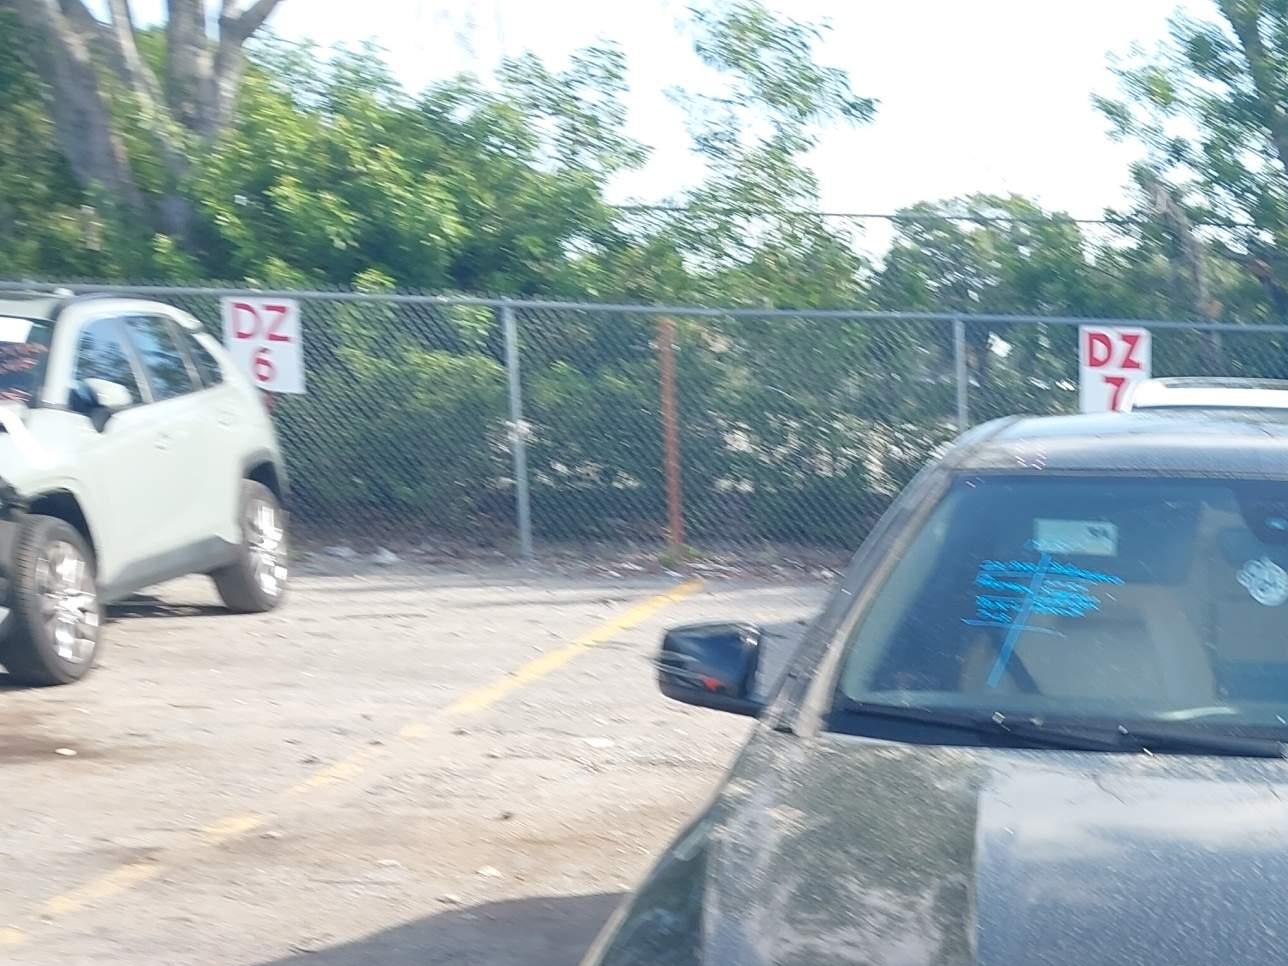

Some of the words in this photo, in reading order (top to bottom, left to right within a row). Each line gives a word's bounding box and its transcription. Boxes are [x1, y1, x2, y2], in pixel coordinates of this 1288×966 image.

[231, 302, 291, 342] DZ
[252, 346, 277, 383] 6
[1087, 332, 1142, 369] DZ
[1103, 375, 1126, 411] 7
